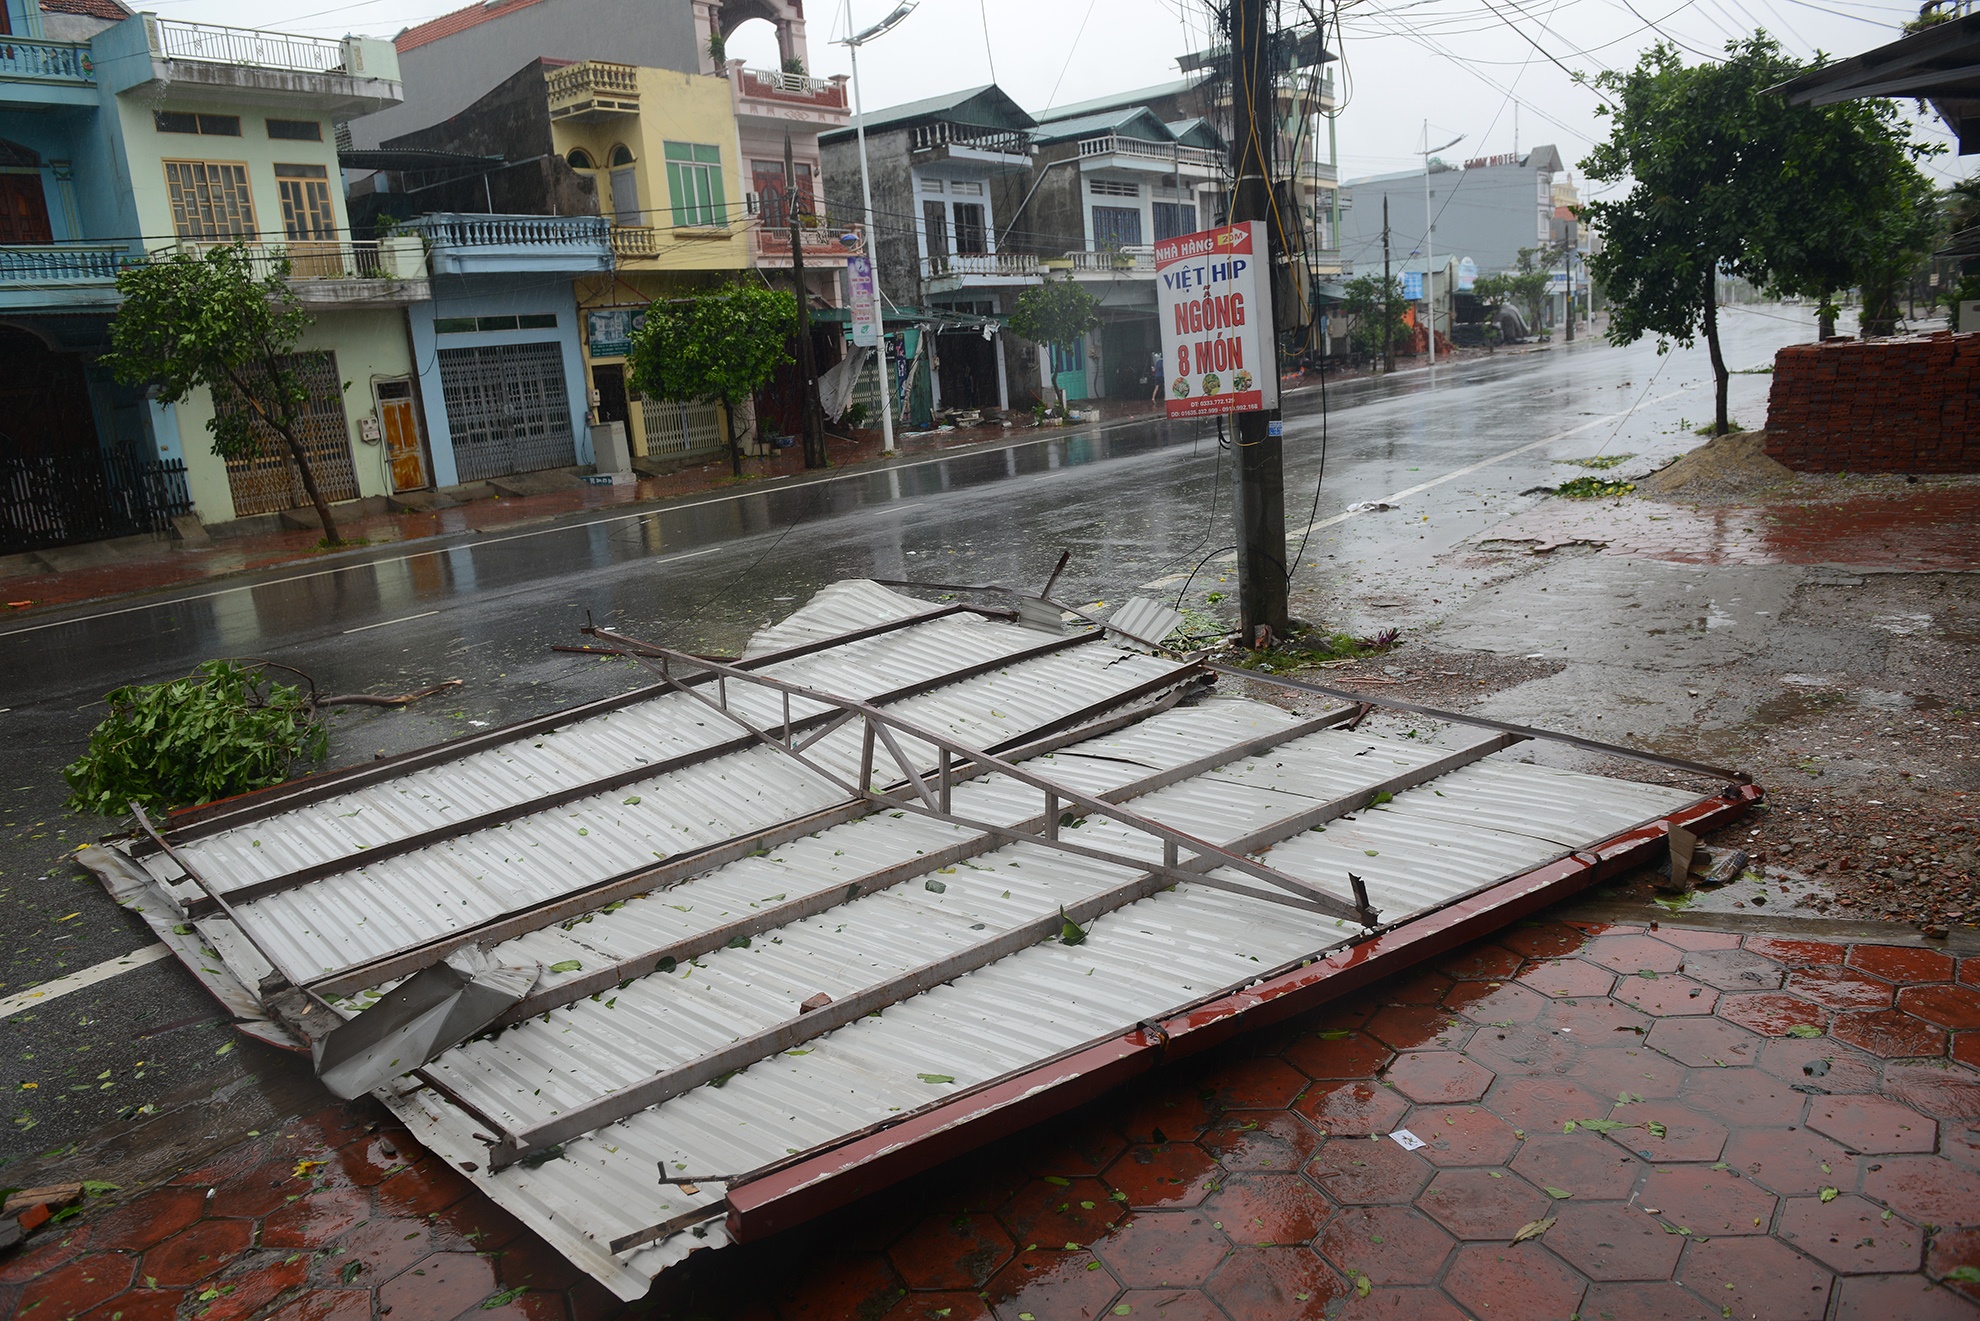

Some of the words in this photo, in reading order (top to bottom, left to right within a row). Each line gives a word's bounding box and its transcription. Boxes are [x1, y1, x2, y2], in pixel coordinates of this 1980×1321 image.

[1489, 152, 1519, 166] MOTEL
[1222, 232, 1243, 243] 20M
[1156, 243, 1178, 261] NHÀ
[1181, 238, 1214, 256] HÀNG
[1163, 265, 1204, 293] VIỆT
[1212, 256, 1247, 283] HÍP
[1174, 284, 1245, 336] NGỖNG
[1178, 345, 1190, 377] 8
[1195, 332, 1243, 375] MÓN
[1222, 403, 1258, 411] 091.992.168
